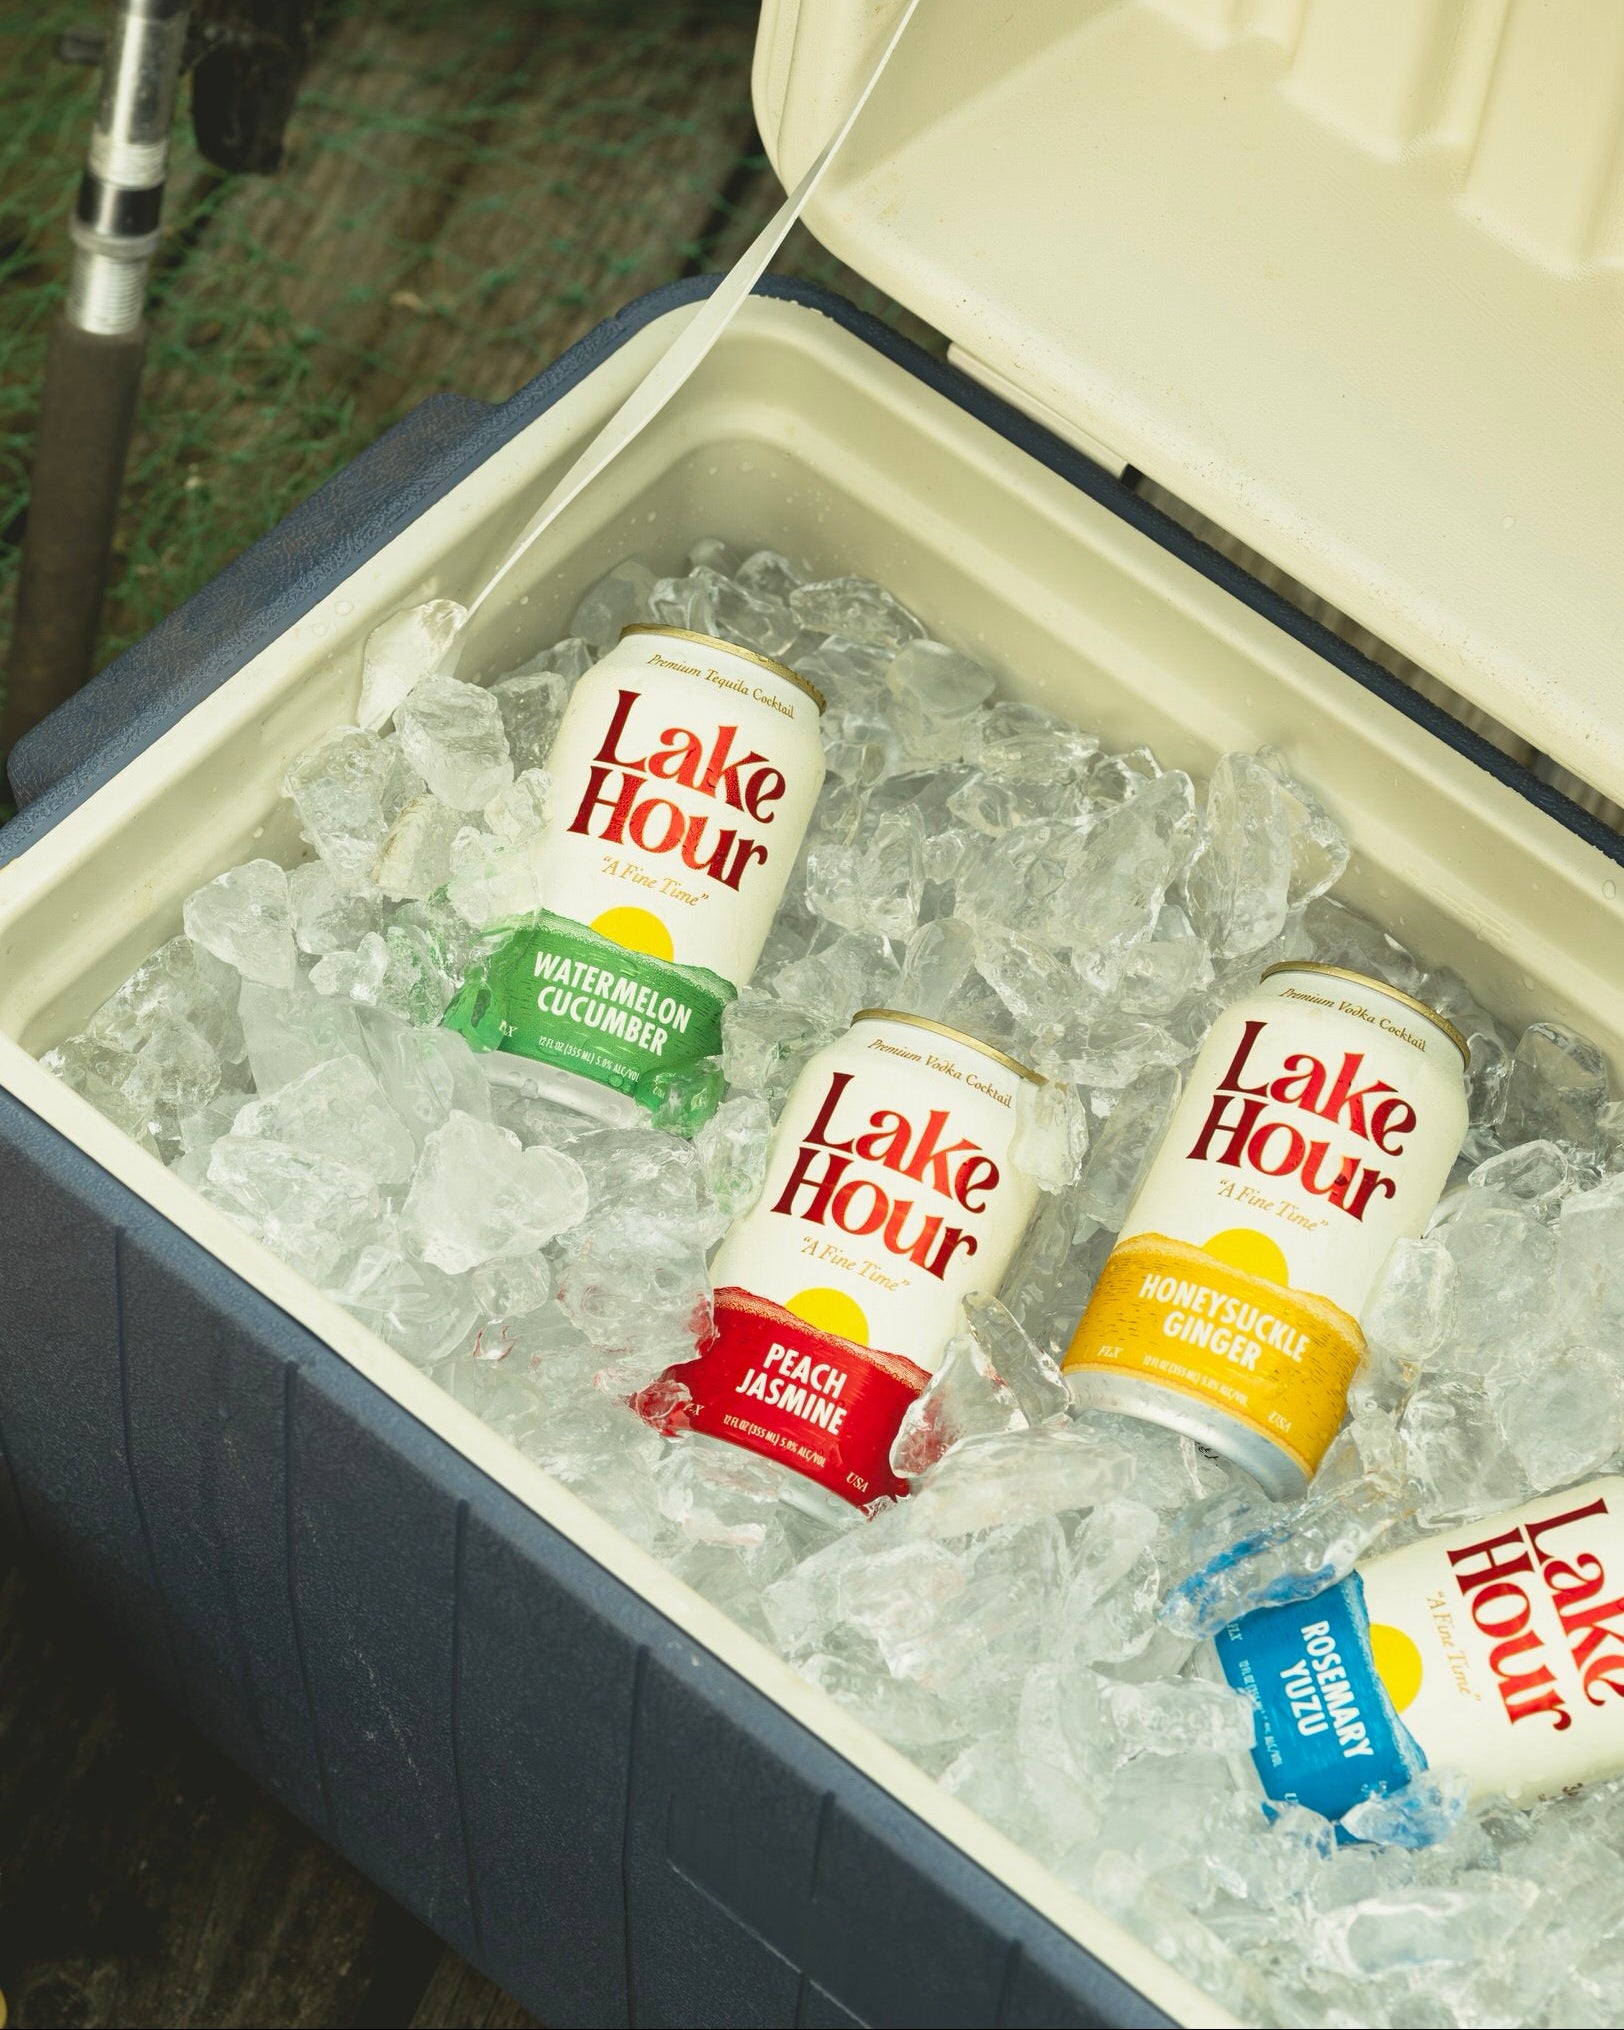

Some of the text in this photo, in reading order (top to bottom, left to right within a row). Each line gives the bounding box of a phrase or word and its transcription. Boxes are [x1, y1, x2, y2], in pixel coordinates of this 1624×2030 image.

[648, 654, 794, 719] Premium Tequila Cocktail
[593, 689, 786, 824] Lake
[566, 765, 768, 892] Hour
[621, 866, 657, 889] Fine
[533, 951, 692, 1034] WATERMELON
[537, 986, 668, 1056] CUCUMBER
[1280, 988, 1427, 1053] Premium Vodka Cocktail
[868, 1039, 1013, 1109] Premium Vodka Cocktail
[1216, 1020, 1417, 1157] Lake
[802, 1072, 1000, 1214] Lake
[1185, 1094, 1396, 1223] Hour
[770, 1147, 978, 1281] Hour
[1236, 1187, 1273, 1211] Fine
[820, 1247, 857, 1272] Fine
[1097, 1345, 1124, 1360] FLX
[1139, 1273, 1310, 1363] HONEYSUCKLE
[1163, 1310, 1262, 1371] GINGER
[736, 1369, 847, 1436] JASMINE
[763, 1343, 847, 1399] PEACH
[1267, 1410, 1293, 1433] USA
[846, 1471, 870, 1493] USA
[1433, 1612, 1455, 1647] Fine
[1446, 1527, 1572, 1731] Hour
[1524, 1497, 1624, 1706] Lake
[1279, 1658, 1329, 1737] YUZU
[1301, 1620, 1375, 1758] ROSEMARY
